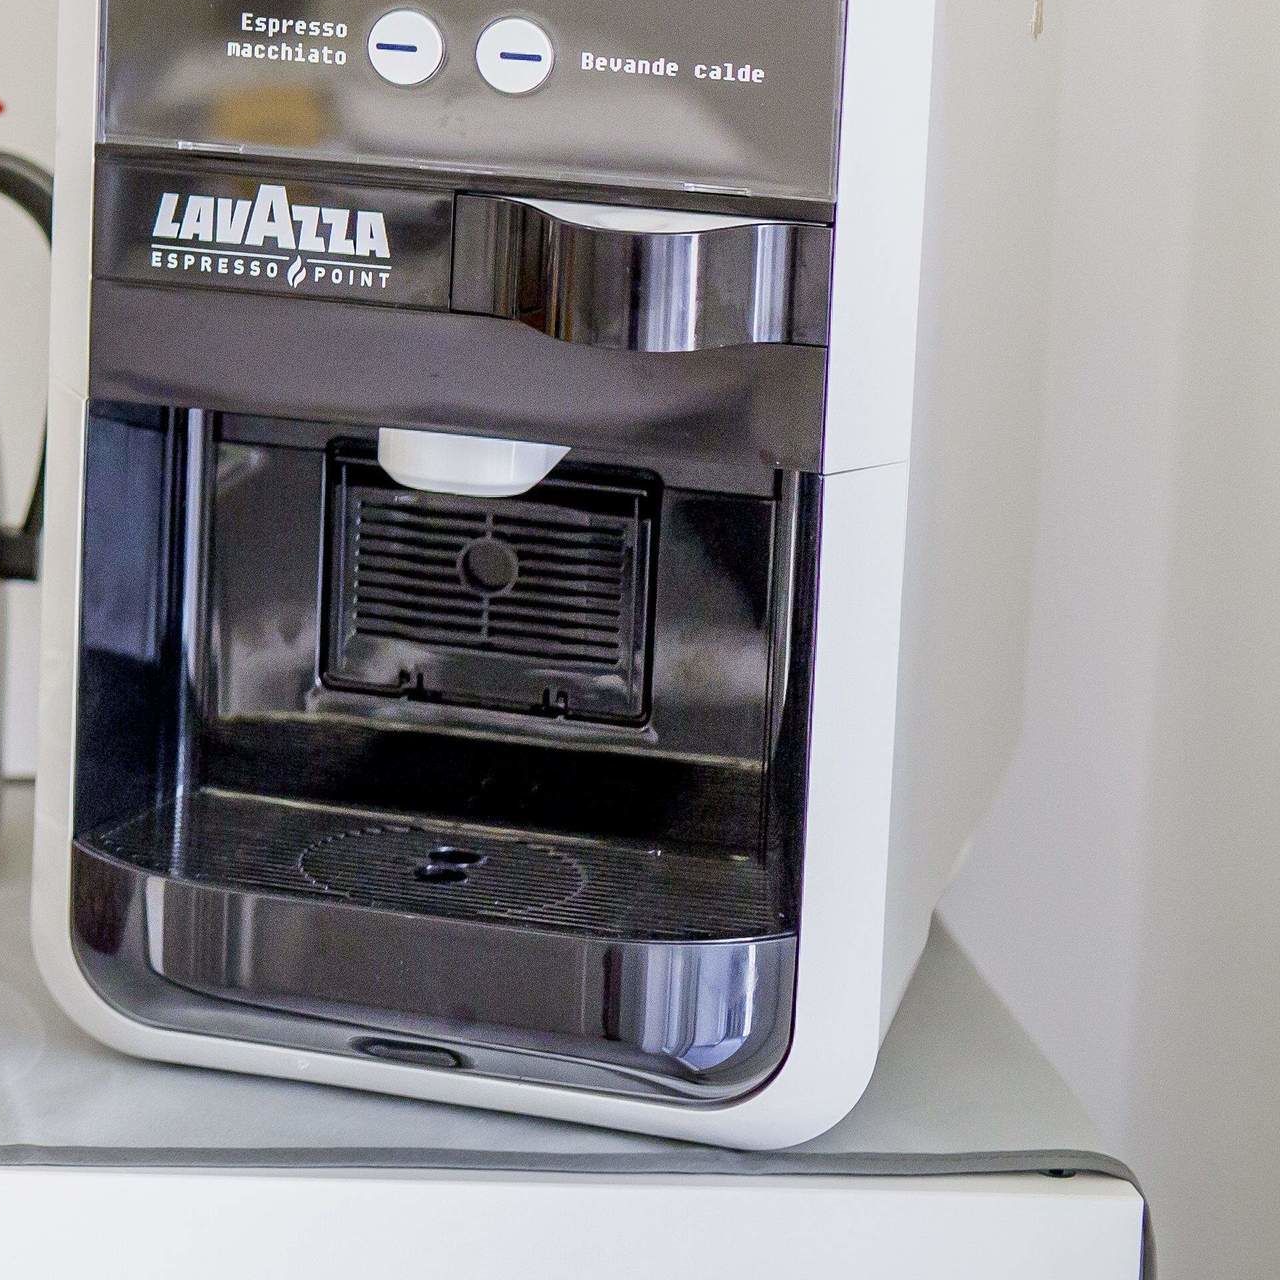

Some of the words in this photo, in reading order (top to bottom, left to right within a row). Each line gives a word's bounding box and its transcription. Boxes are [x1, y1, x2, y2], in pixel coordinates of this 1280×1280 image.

[240, 12, 348, 39] Espresso
[226, 41, 347, 66] macchiato
[580, 51, 679, 77] Bevande
[693, 62, 766, 84] calde
[152, 184, 391, 259] LAVAZZA
[151, 251, 279, 278] ESPRESSO
[314, 267, 390, 289] POINT
